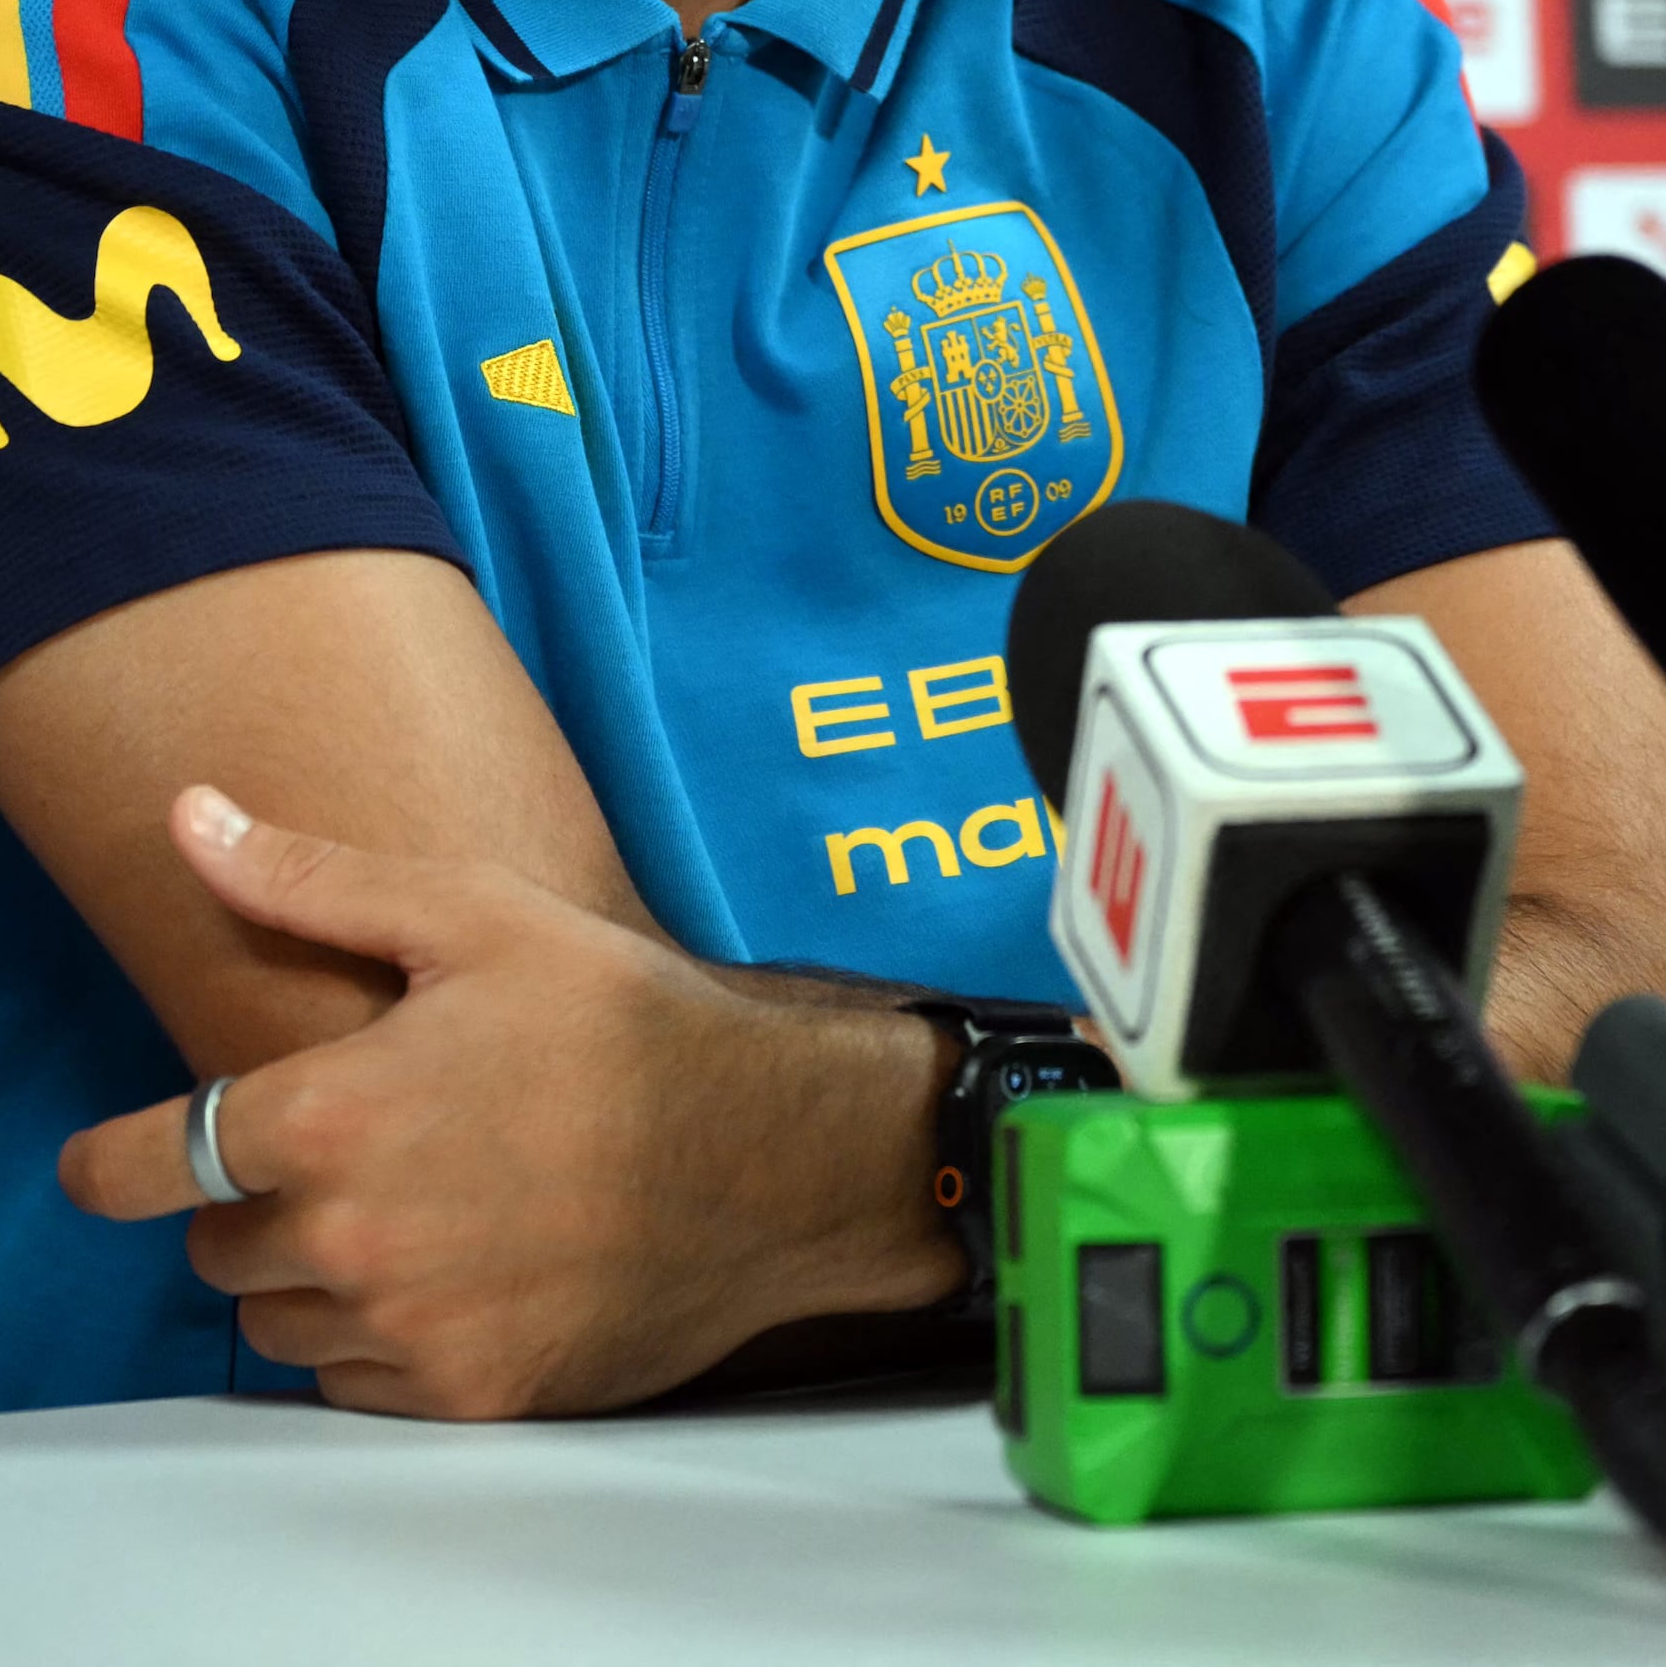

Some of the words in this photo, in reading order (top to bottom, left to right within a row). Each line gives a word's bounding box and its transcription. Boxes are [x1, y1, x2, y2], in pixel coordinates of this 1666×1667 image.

[1046, 479, 1073, 501] 09
[944, 503, 968, 524] 19
[791, 654, 1014, 758] EB
